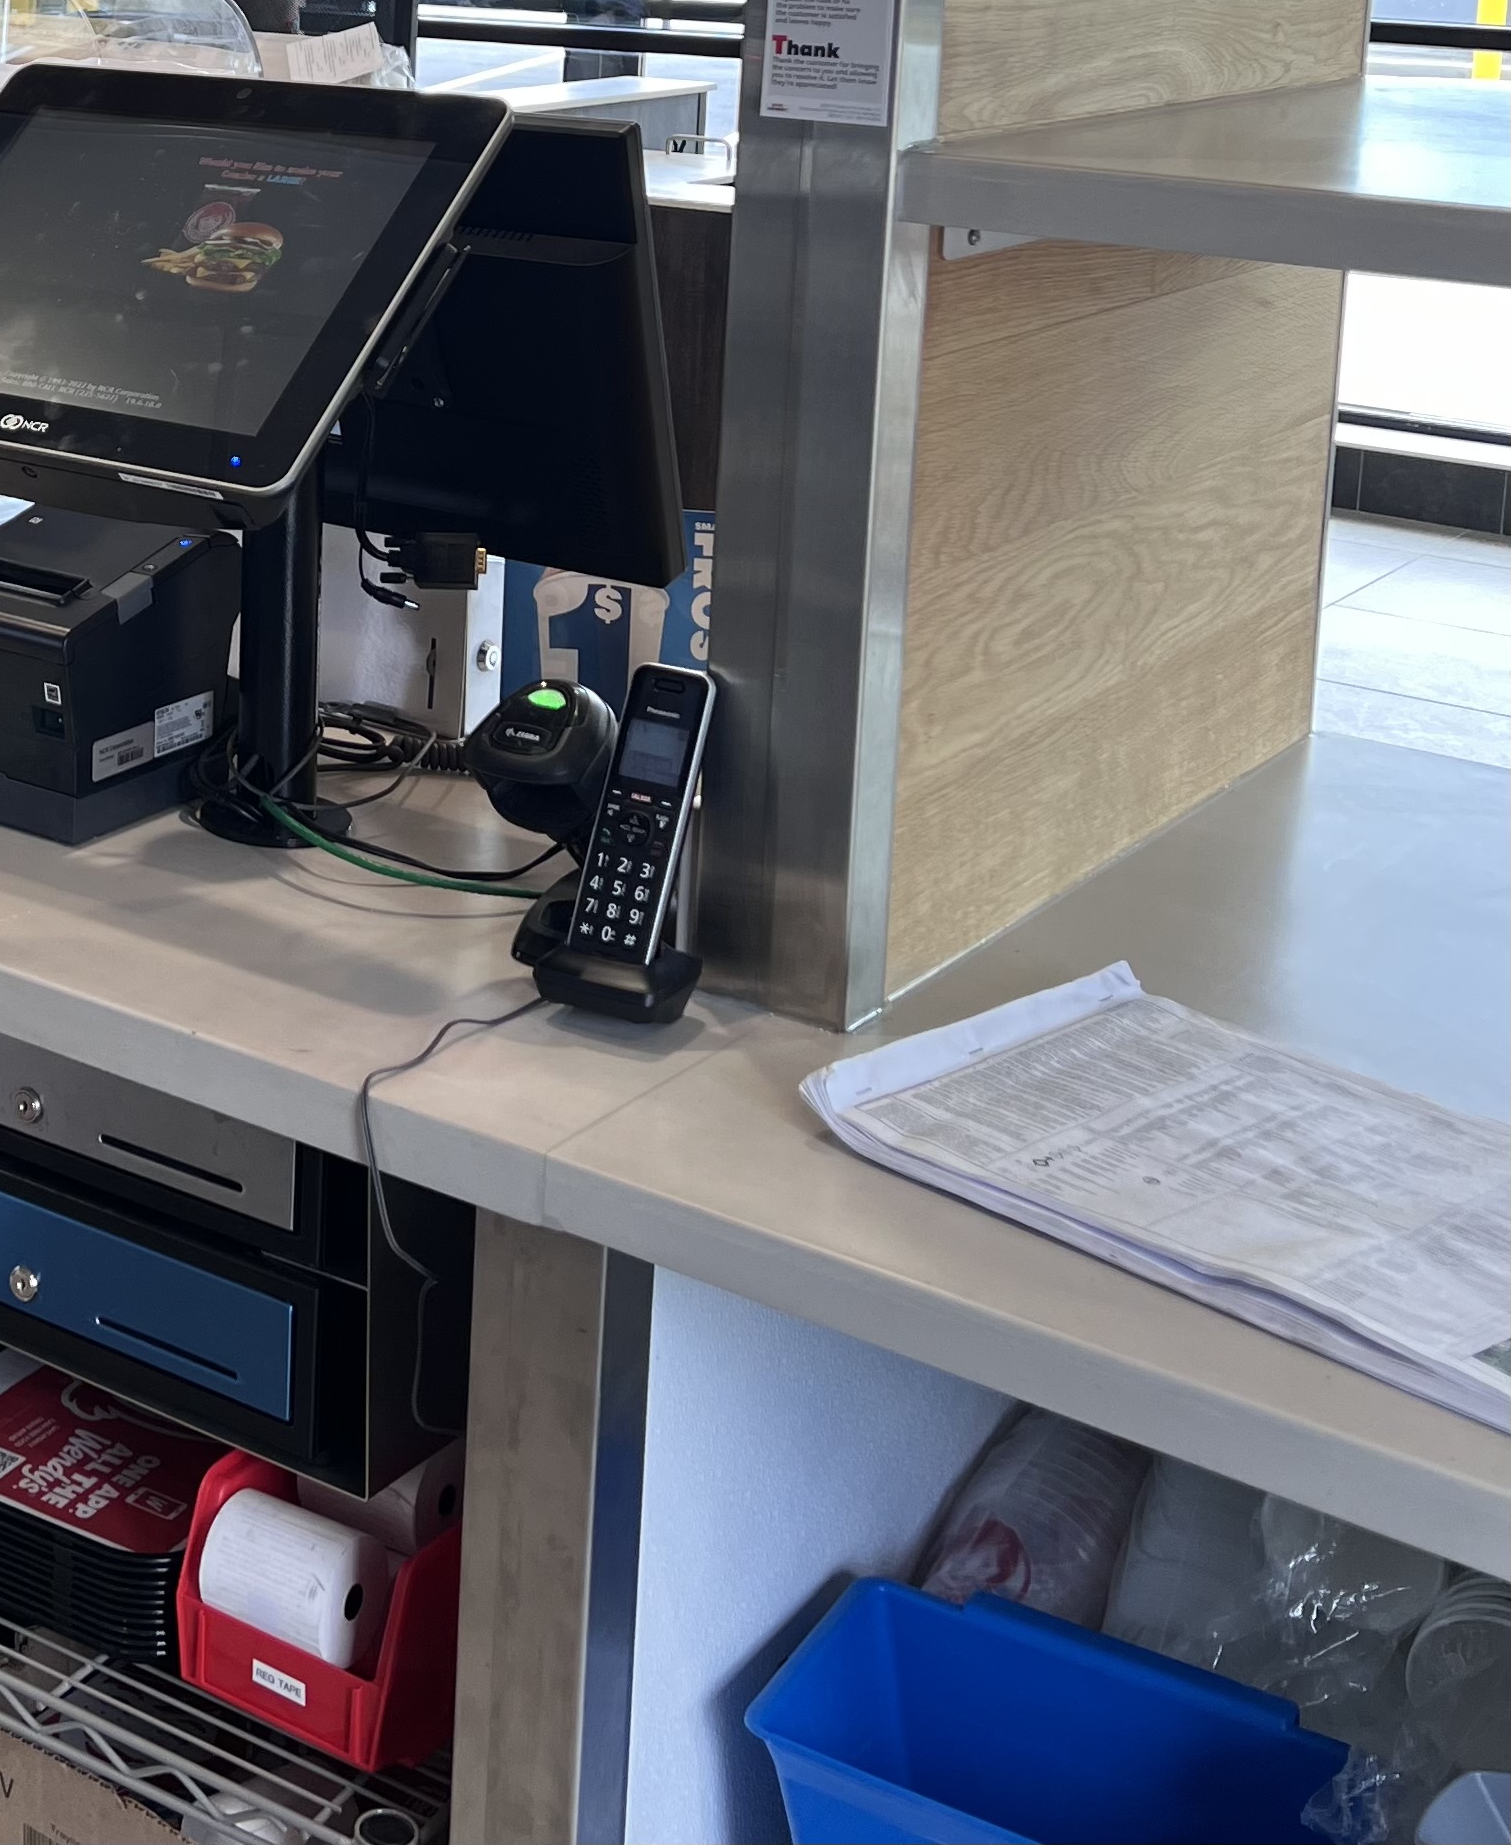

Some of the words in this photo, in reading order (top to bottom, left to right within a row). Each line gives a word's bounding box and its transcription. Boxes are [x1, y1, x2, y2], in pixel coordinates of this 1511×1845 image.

[770, 34, 840, 59] Thank
[22, 421, 49, 433] NCR
[598, 852, 604, 867] 1
[617, 857, 628, 873] 2
[640, 863, 650, 878] 3
[590, 875, 599, 890] 4
[612, 880, 623, 895] 5
[634, 886, 644, 901] 6
[585, 898, 595, 912] 7
[606, 903, 617, 919] 8
[629, 909, 639, 924] 9
[601, 926, 611, 942] 0
[84, 1443, 133, 1474] ALL
[113, 1455, 161, 1488] ONE
[41, 1472, 99, 1509] THE
[278, 1678, 302, 1699] TAPE
